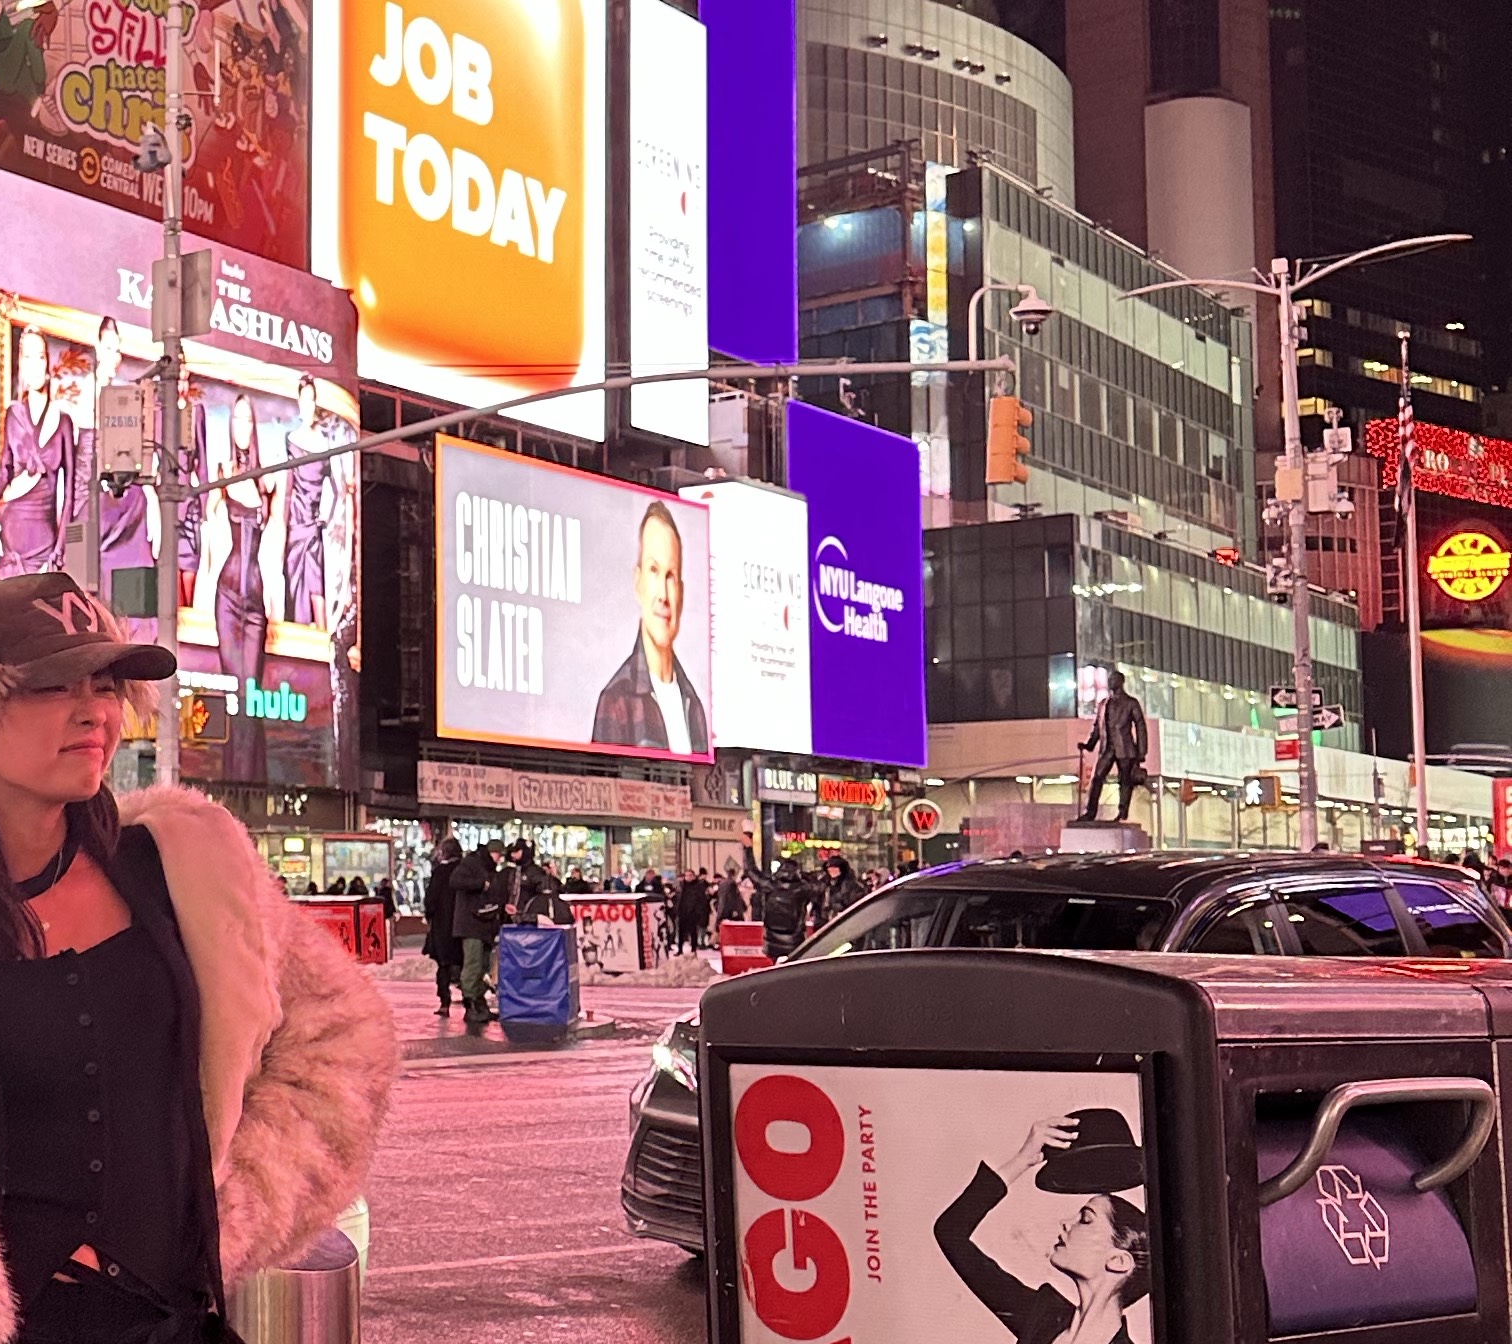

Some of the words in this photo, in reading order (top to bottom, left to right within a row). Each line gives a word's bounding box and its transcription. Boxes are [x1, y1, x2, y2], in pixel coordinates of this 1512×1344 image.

[369, 1, 494, 126] JOB
[23, 135, 45, 159] NEW
[46, 142, 78, 171] SERIES
[184, 185, 214, 224] 10PM
[363, 111, 568, 265] TODAY
[215, 278, 252, 304] THE
[455, 491, 582, 604] CHRISTIAN
[819, 563, 849, 600] NYU
[849, 571, 904, 613] Langone
[456, 593, 544, 696] SLATER
[843, 604, 889, 643] Health
[247, 676, 308, 722] hulu
[764, 768, 795, 791] BLUE
[796, 772, 817, 793] FIN
[911, 809, 938, 830] W
[858, 1105, 876, 1174] PARTY
[863, 1181, 878, 1221] THE
[866, 1228, 882, 1284] JOIN
